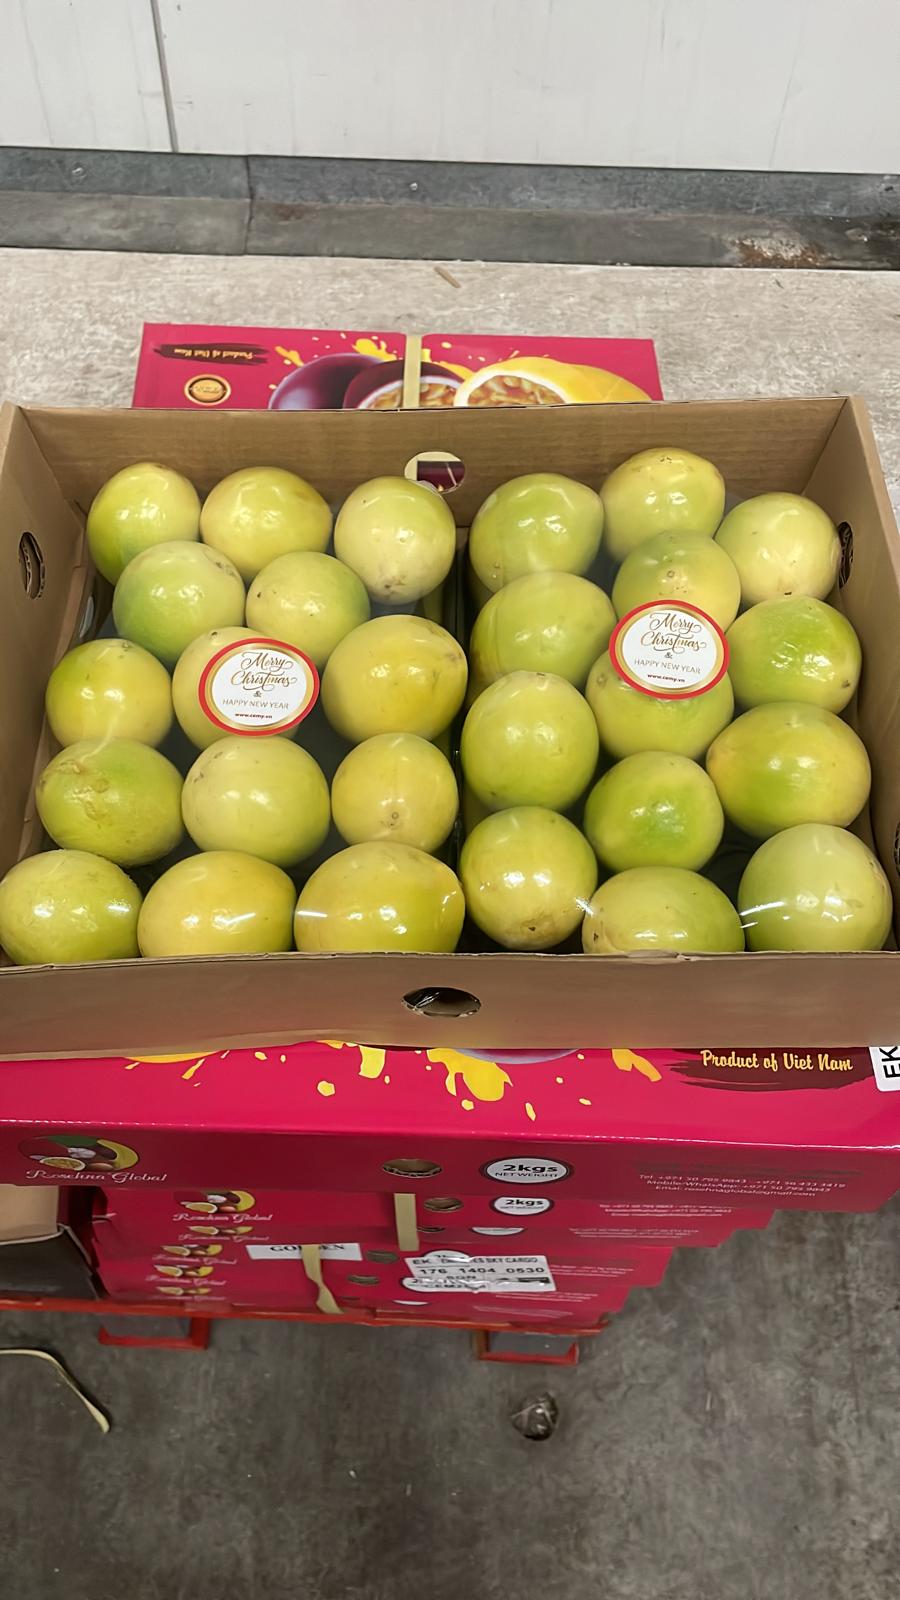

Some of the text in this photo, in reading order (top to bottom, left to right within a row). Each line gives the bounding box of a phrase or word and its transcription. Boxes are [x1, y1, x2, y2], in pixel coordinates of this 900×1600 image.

[649, 612, 702, 634] Merry
[640, 631, 707, 654] Christmas
[240, 652, 294, 672] Merry
[634, 658, 702, 674] HAPPY NEW YEAR
[231, 670, 298, 691] Christmas
[222, 698, 289, 709] HAPPY NEW YEAR
[700, 1049, 854, 1072] Product of Viet Nam
[111, 1172, 168, 1183] Global
[503, 1164, 558, 1173] 2kgs
